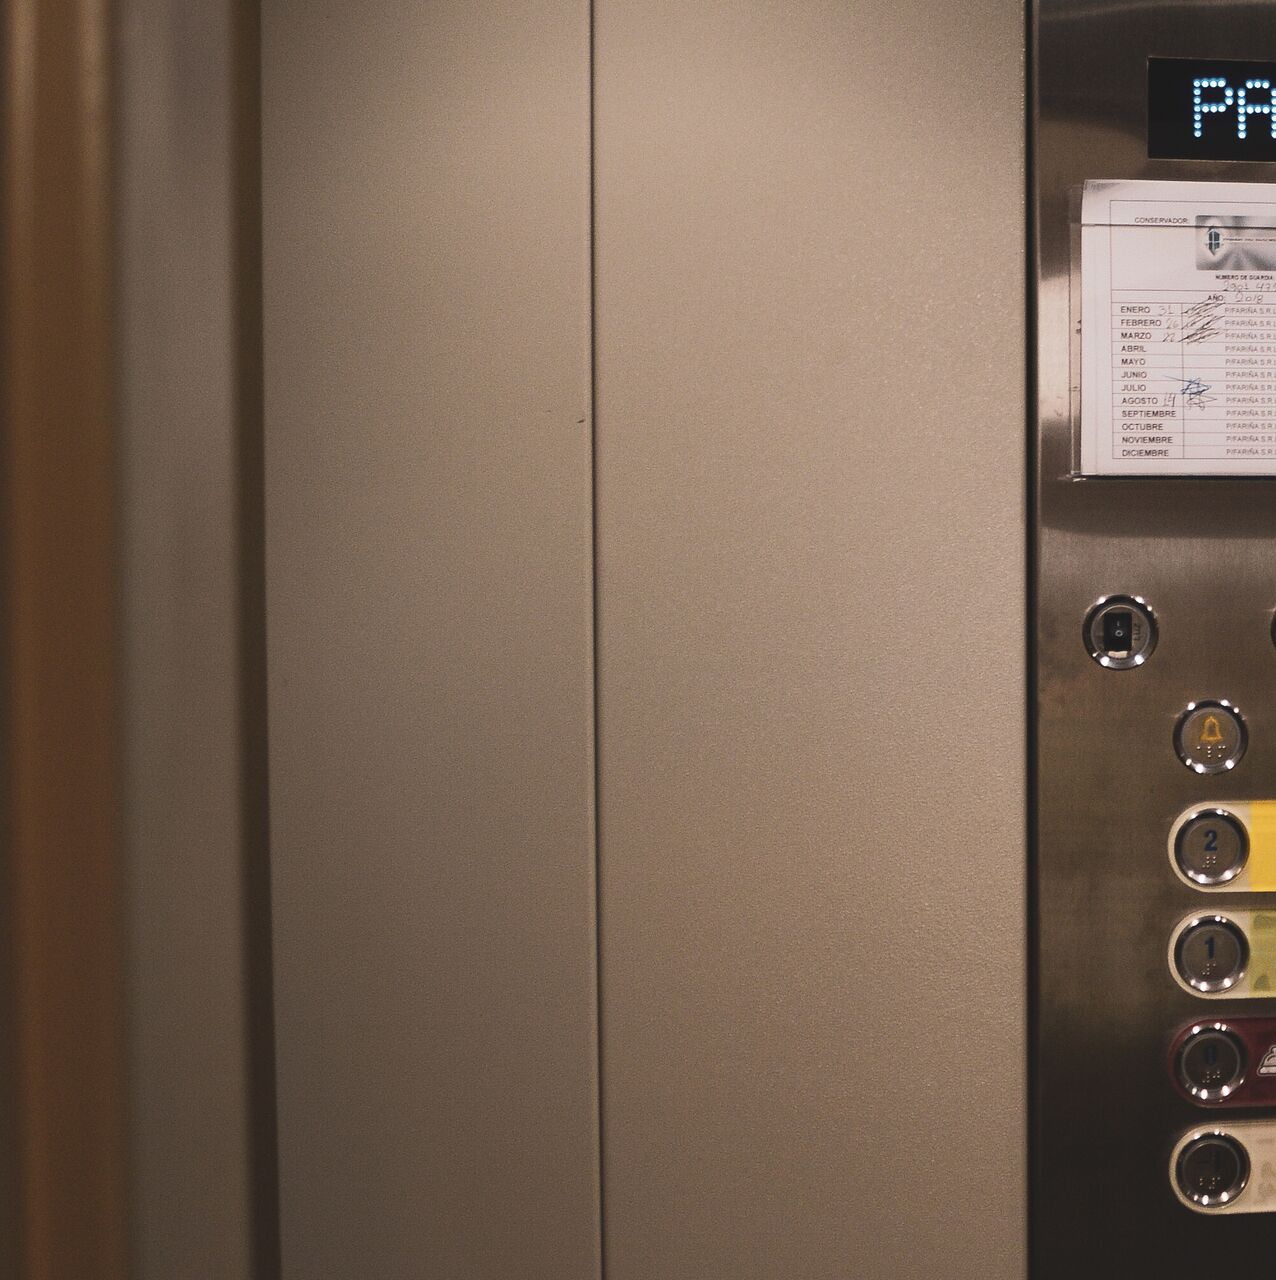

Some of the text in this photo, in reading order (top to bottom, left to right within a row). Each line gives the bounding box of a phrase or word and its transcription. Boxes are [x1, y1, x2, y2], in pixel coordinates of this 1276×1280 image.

[1120, 319, 1162, 327] FEBRERO
[1121, 345, 1146, 353] ABRIL
[1121, 358, 1146, 366] MAYO
[1121, 384, 1146, 392] JULIO
[1122, 397, 1158, 405] AGOSTO
[1122, 423, 1163, 431] OCTUBRE
[1122, 436, 1173, 444] NOVIEMBRE
[1204, 829, 1218, 852] 2
[1204, 936, 1215, 960] 1
